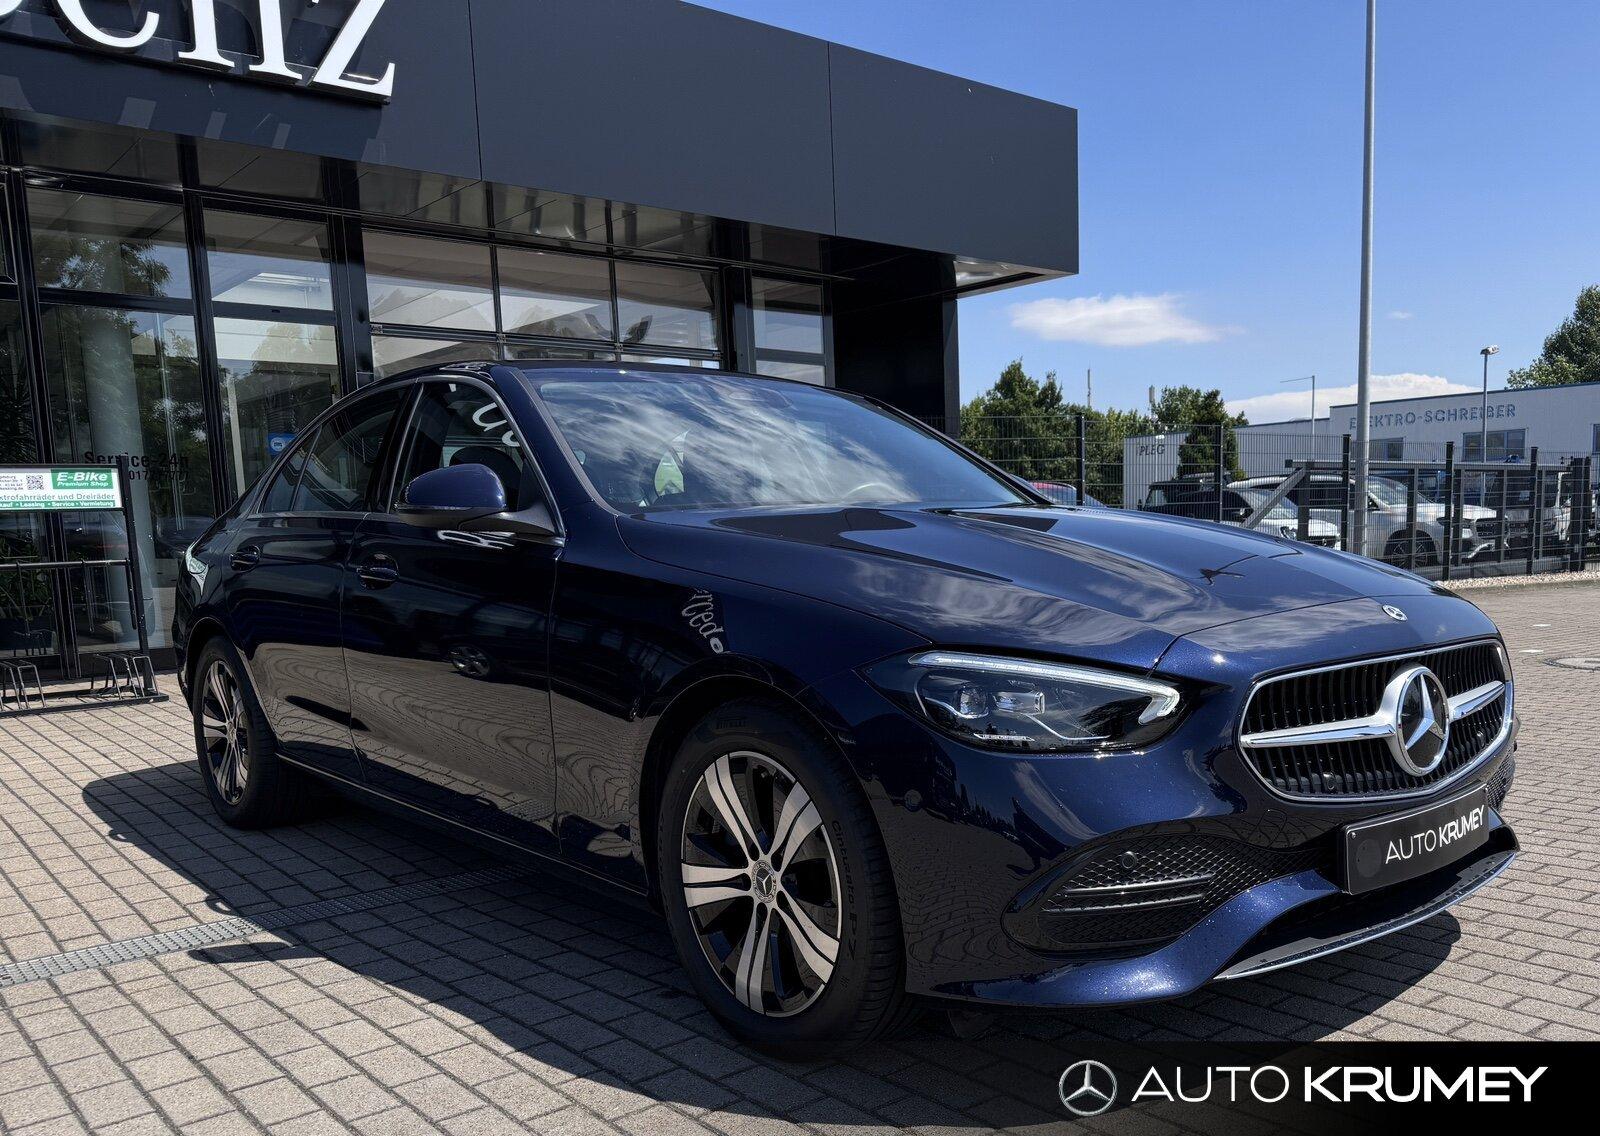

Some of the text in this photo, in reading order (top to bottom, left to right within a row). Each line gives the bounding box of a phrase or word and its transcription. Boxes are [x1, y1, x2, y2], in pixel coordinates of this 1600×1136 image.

[1349, 403, 1516, 430] EEKTRO-SCHREIBER
[57, 471, 108, 481] E-Bike
[1385, 804, 1485, 865] AUTO KRUMEY
